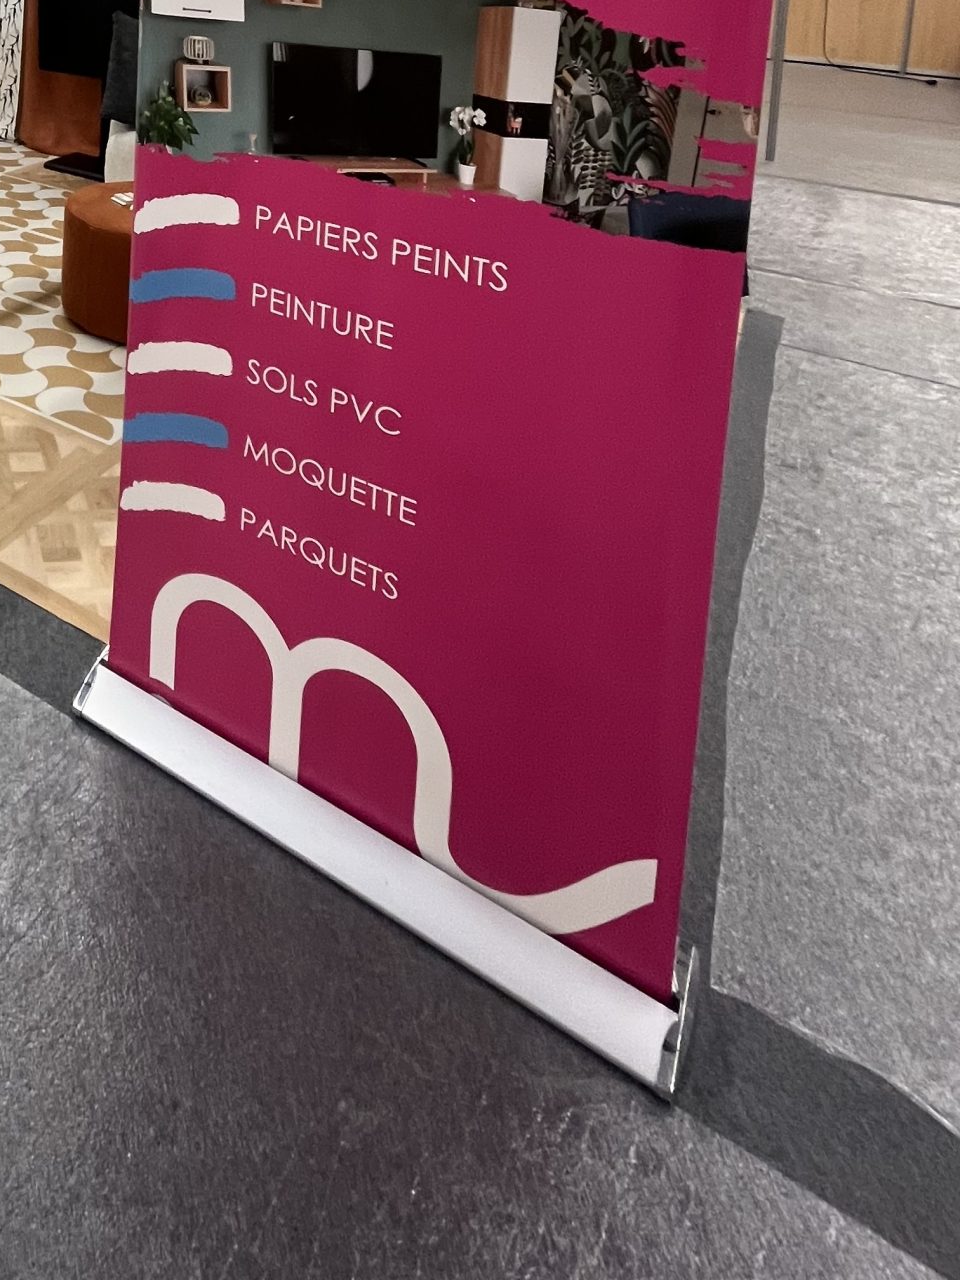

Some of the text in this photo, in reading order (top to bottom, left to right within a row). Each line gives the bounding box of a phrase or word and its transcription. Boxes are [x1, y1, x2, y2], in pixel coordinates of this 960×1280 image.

[255, 205, 509, 292] PAPIERS PEINTS
[251, 282, 395, 350] PEINTURE
[246, 359, 402, 436] SOLS PVC
[243, 436, 418, 526] MOQUETTE
[241, 507, 399, 600] PARQUETS
